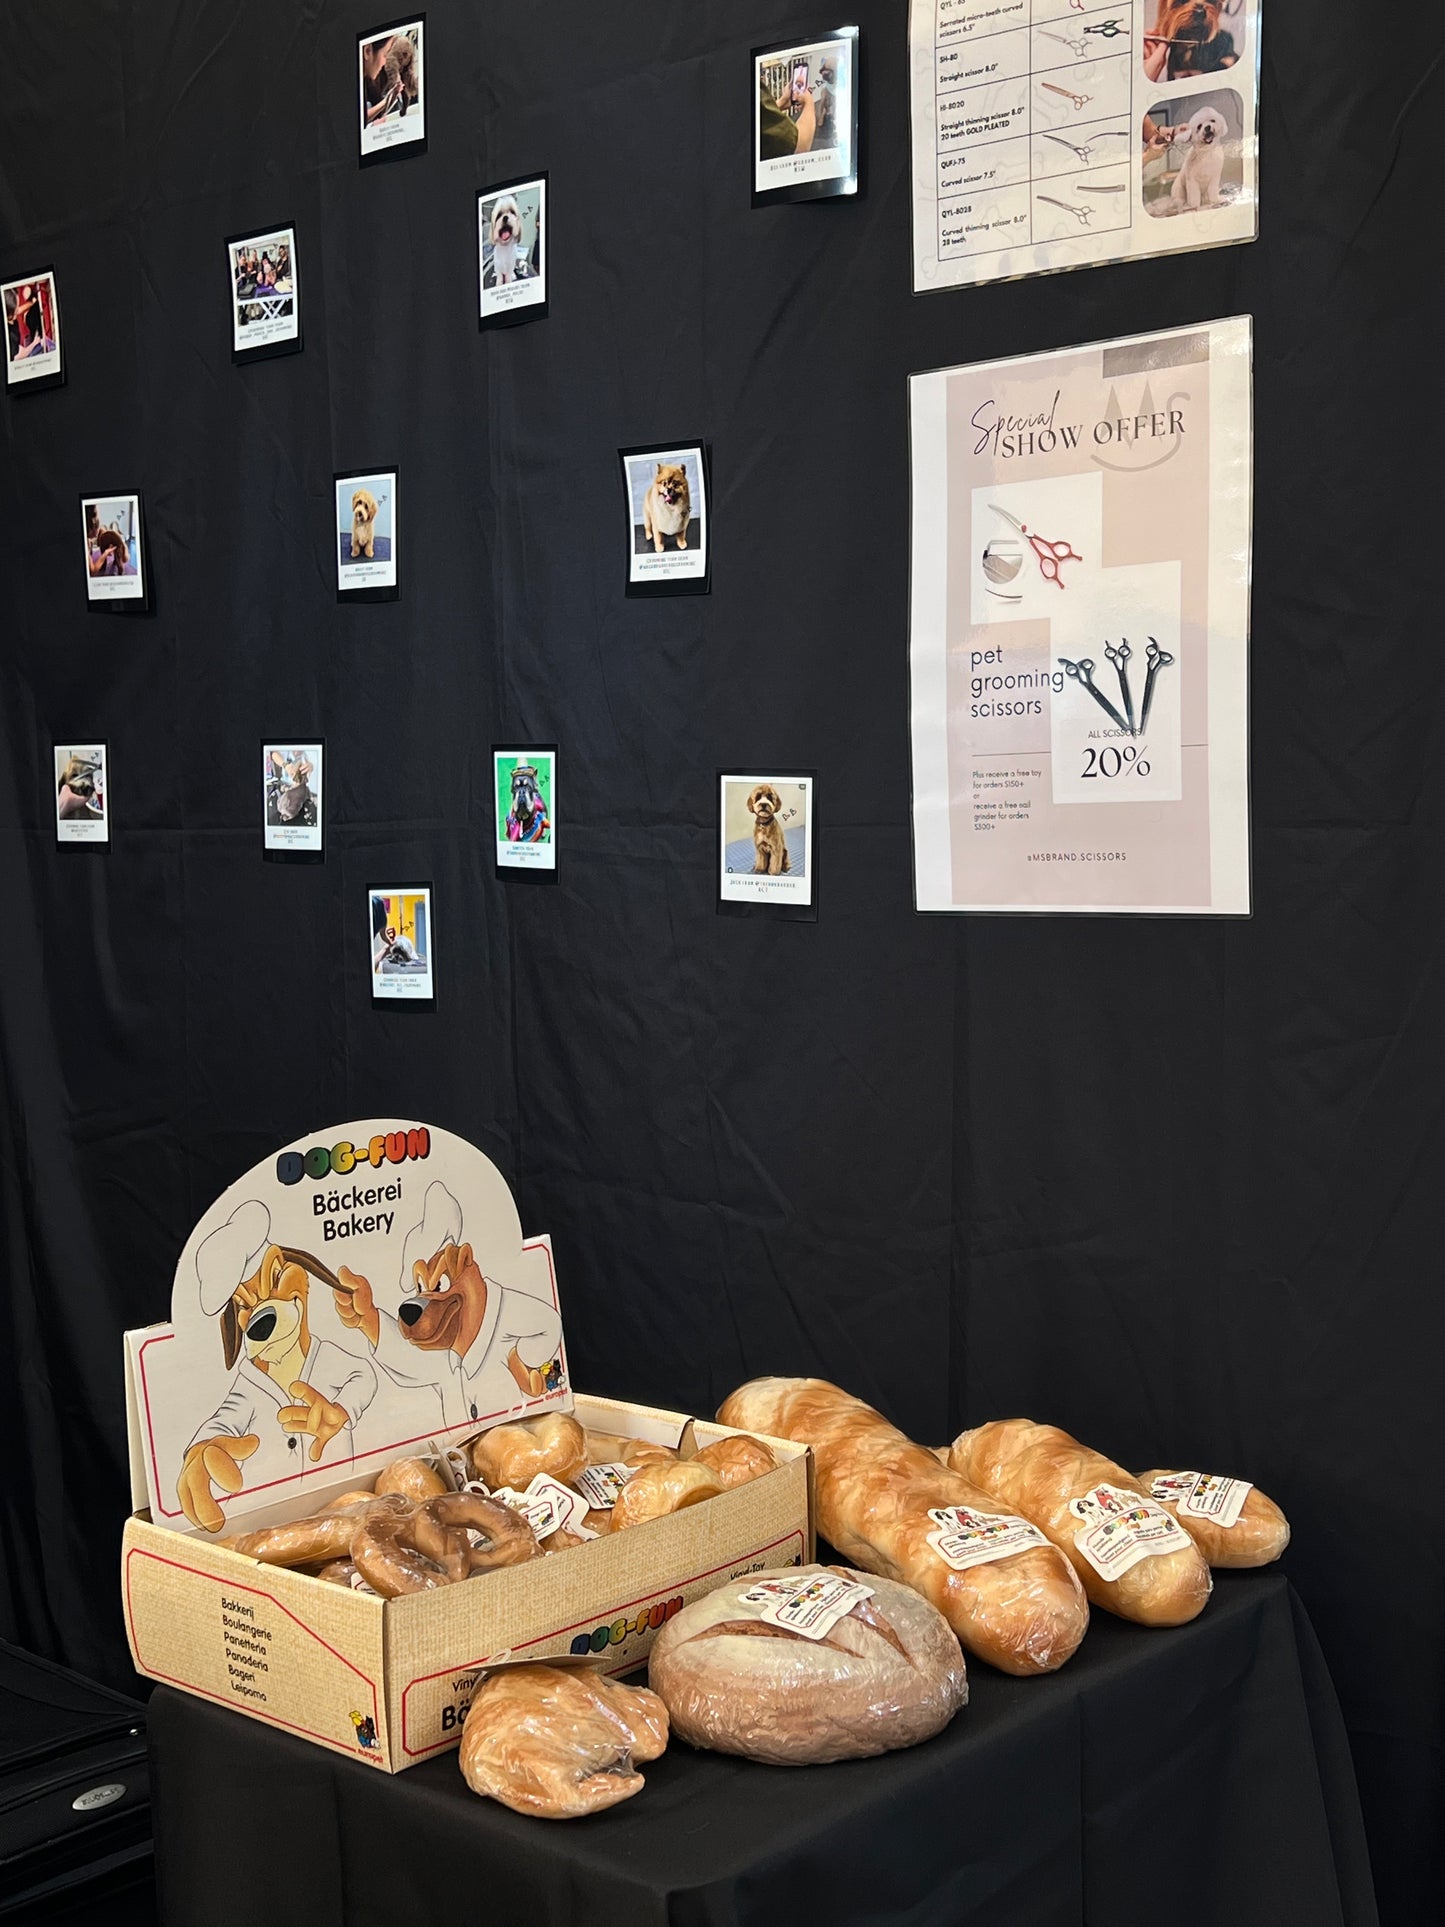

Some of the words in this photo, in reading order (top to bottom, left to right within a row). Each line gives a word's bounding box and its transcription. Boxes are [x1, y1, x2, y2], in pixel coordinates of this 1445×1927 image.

[940, 16, 966, 28] Serrated
[967, 8, 1001, 21] micro-teeth
[1002, 3, 1023, 13] curved
[940, 29, 961, 38] scissors
[940, 73, 964, 83] Straight
[965, 68, 984, 77] scissor
[941, 120, 964, 131] Straight
[965, 115, 989, 127] thinning
[991, 111, 1010, 120] scissor
[941, 132, 949, 141] 20
[950, 129, 966, 138] teeth
[966, 126, 983, 135] GOLD
[984, 120, 1010, 131] PLEATED
[941, 178, 963, 187] Curved
[964, 174, 983, 183] scissor
[942, 226, 963, 236] Curved
[965, 222, 989, 233] thinning
[992, 219, 1011, 227] scissor
[951, 236, 967, 244] teeth
[971, 389, 1060, 457] Special
[1001, 424, 1084, 459] SHOW
[1093, 410, 1186, 445] OFFER
[970, 645, 1003, 672] pet
[970, 669, 1064, 699] grooming
[970, 699, 1042, 718] scissors
[1088, 730, 1101, 739] ALL
[1103, 728, 1142, 738] SCISSORS
[1081, 745, 1152, 779] 20%
[1017, 768, 1030, 777] free
[1031, 769, 1042, 778] toy
[973, 781, 982, 789] for
[983, 780, 1003, 788] orders
[973, 802, 997, 810] receive
[1004, 800, 1018, 808] free
[1019, 800, 1031, 809] nail
[974, 813, 997, 823] grinder
[998, 811, 1008, 819] for
[277, 1127, 431, 1186] DOG-FUN
[313, 1177, 402, 1216] Bäckerei
[324, 1211, 394, 1242] Bakery
[221, 1598, 255, 1621] Bakkerij
[222, 1614, 273, 1642] Boulangerie
[570, 1595, 684, 1655] DOG-FUN
[224, 1631, 268, 1656] Panetteria
[228, 1664, 256, 1682] Bageri
[452, 1676, 478, 1692] Viny
